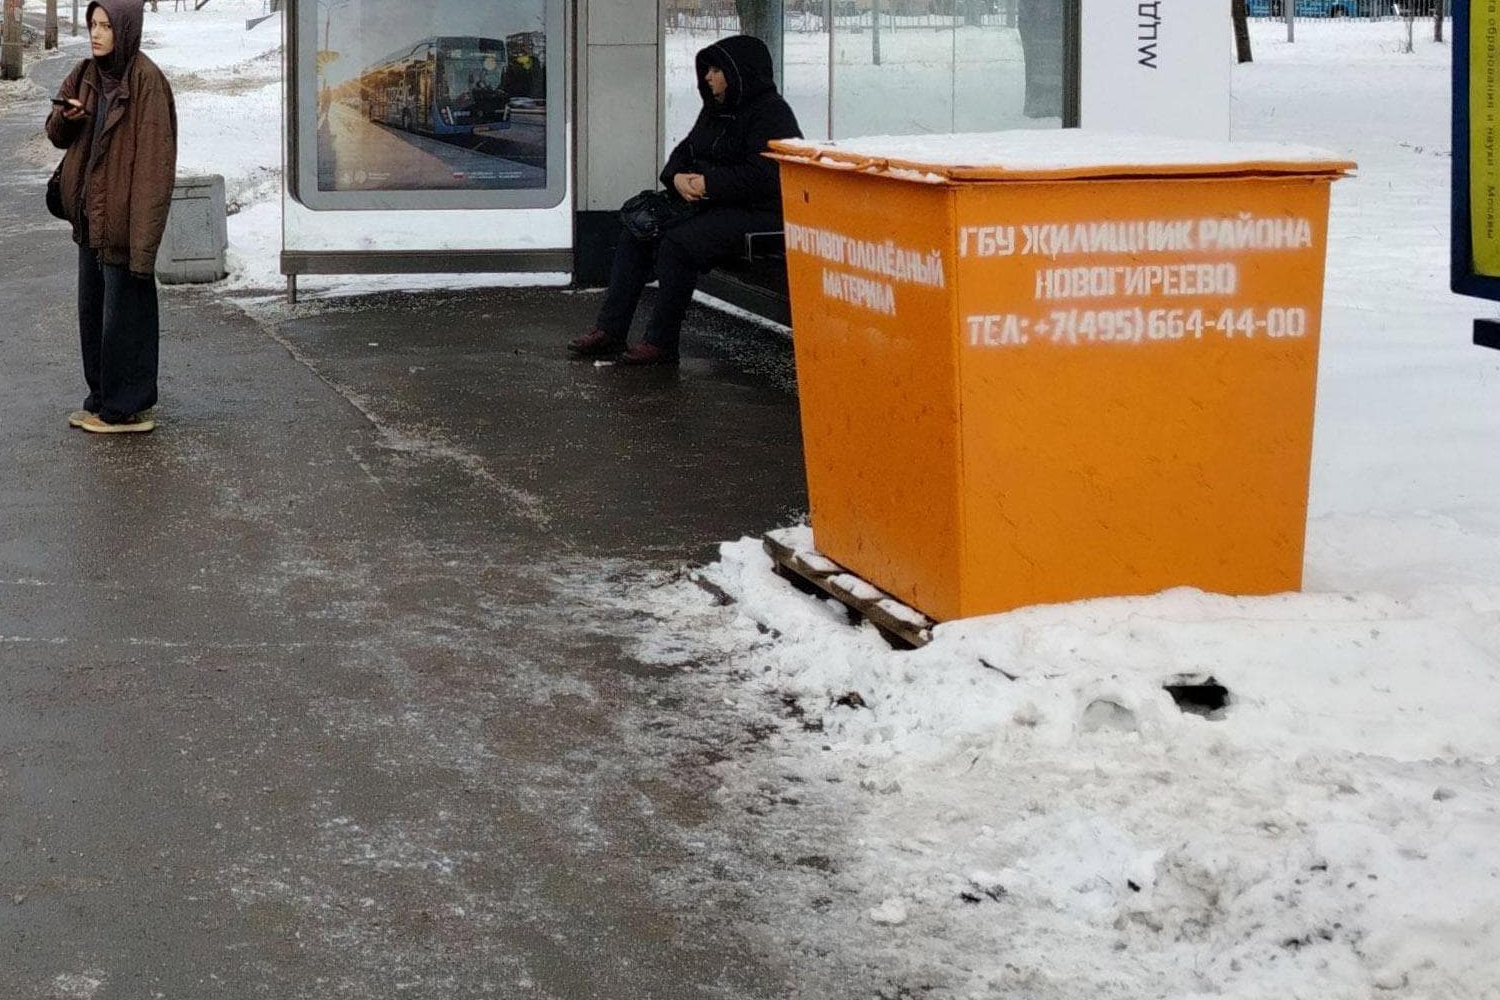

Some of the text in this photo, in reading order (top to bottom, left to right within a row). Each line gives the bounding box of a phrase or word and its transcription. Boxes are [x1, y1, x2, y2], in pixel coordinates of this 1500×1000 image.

[1138, 0, 1161, 69] МЦД
[959, 211, 1313, 258] ГБУ ЖИЛИЩНИК РАЙОНА
[1034, 261, 1237, 300] НОВОГИРЕЕВО
[966, 313, 1030, 346] ТЕЛ:
